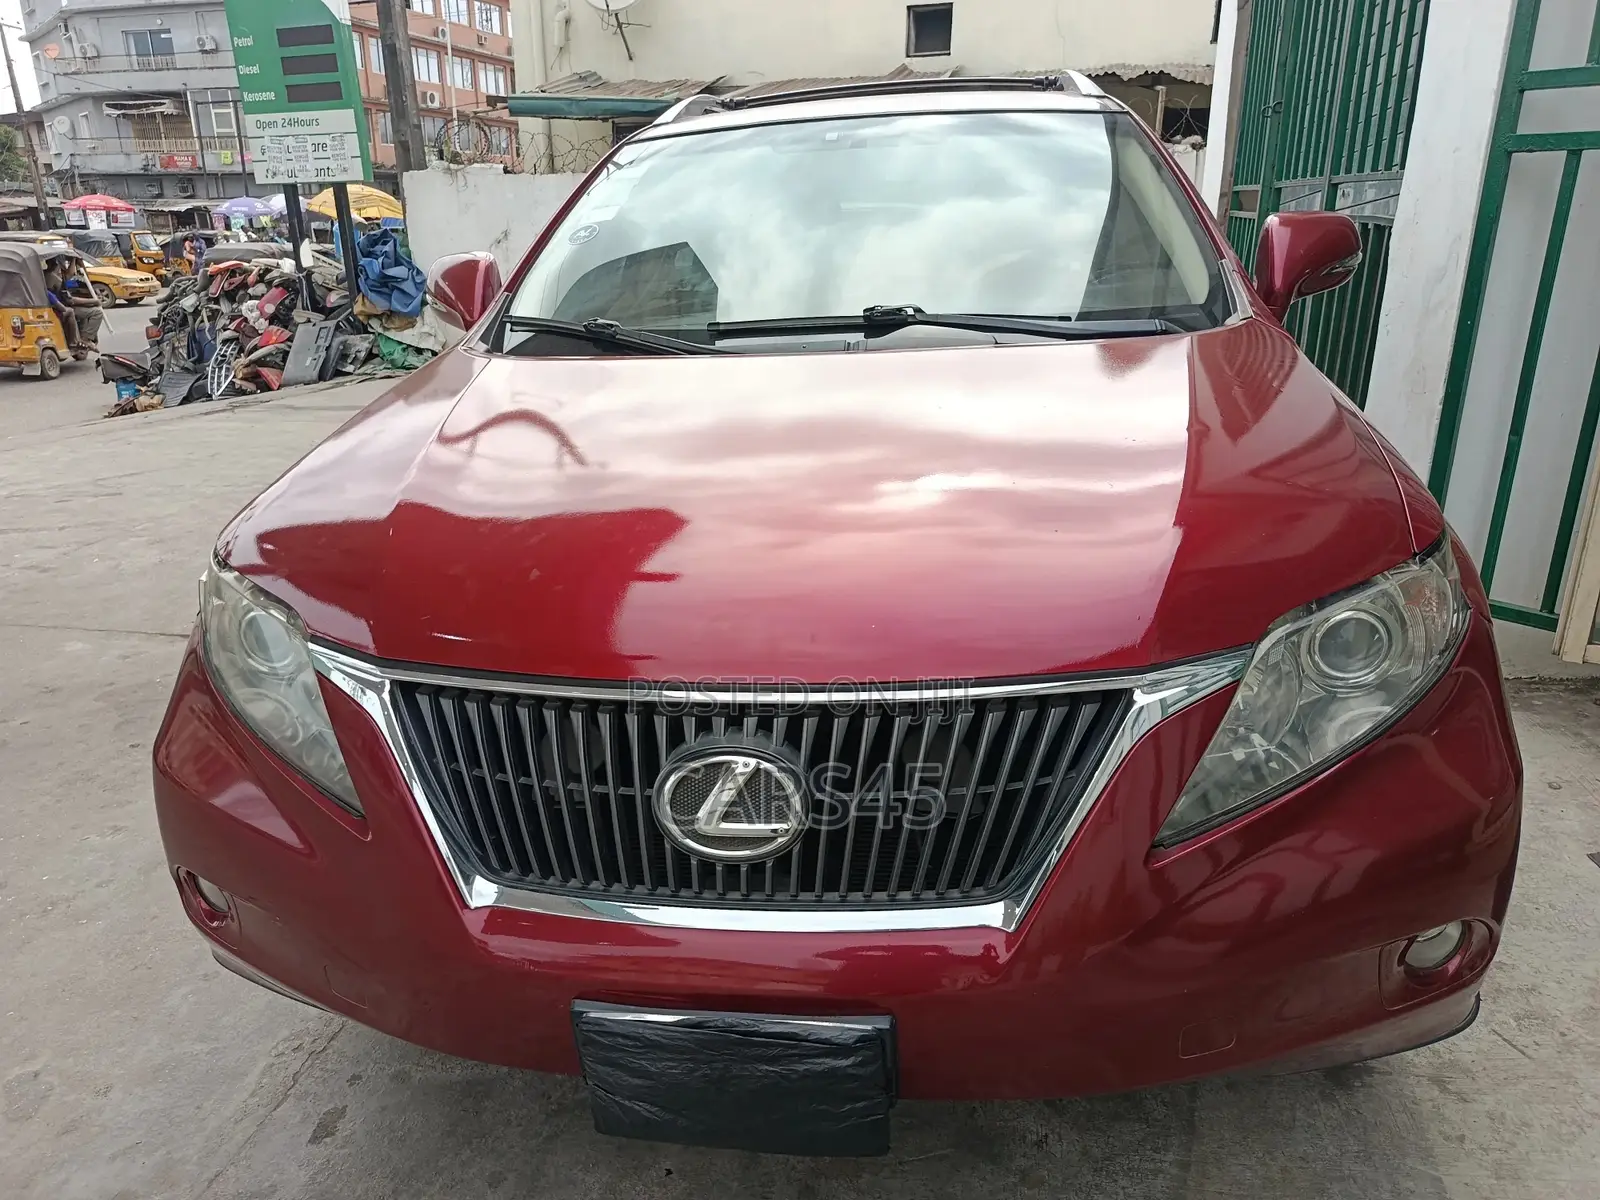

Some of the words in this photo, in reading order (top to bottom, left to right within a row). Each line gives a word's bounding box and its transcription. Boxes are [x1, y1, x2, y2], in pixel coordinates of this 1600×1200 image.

[233, 36, 253, 47] Petrol
[238, 64, 260, 75] Diesel
[243, 91, 275, 102] Kerosene
[255, 119, 278, 131] Open
[281, 117, 320, 129] 24Hours
